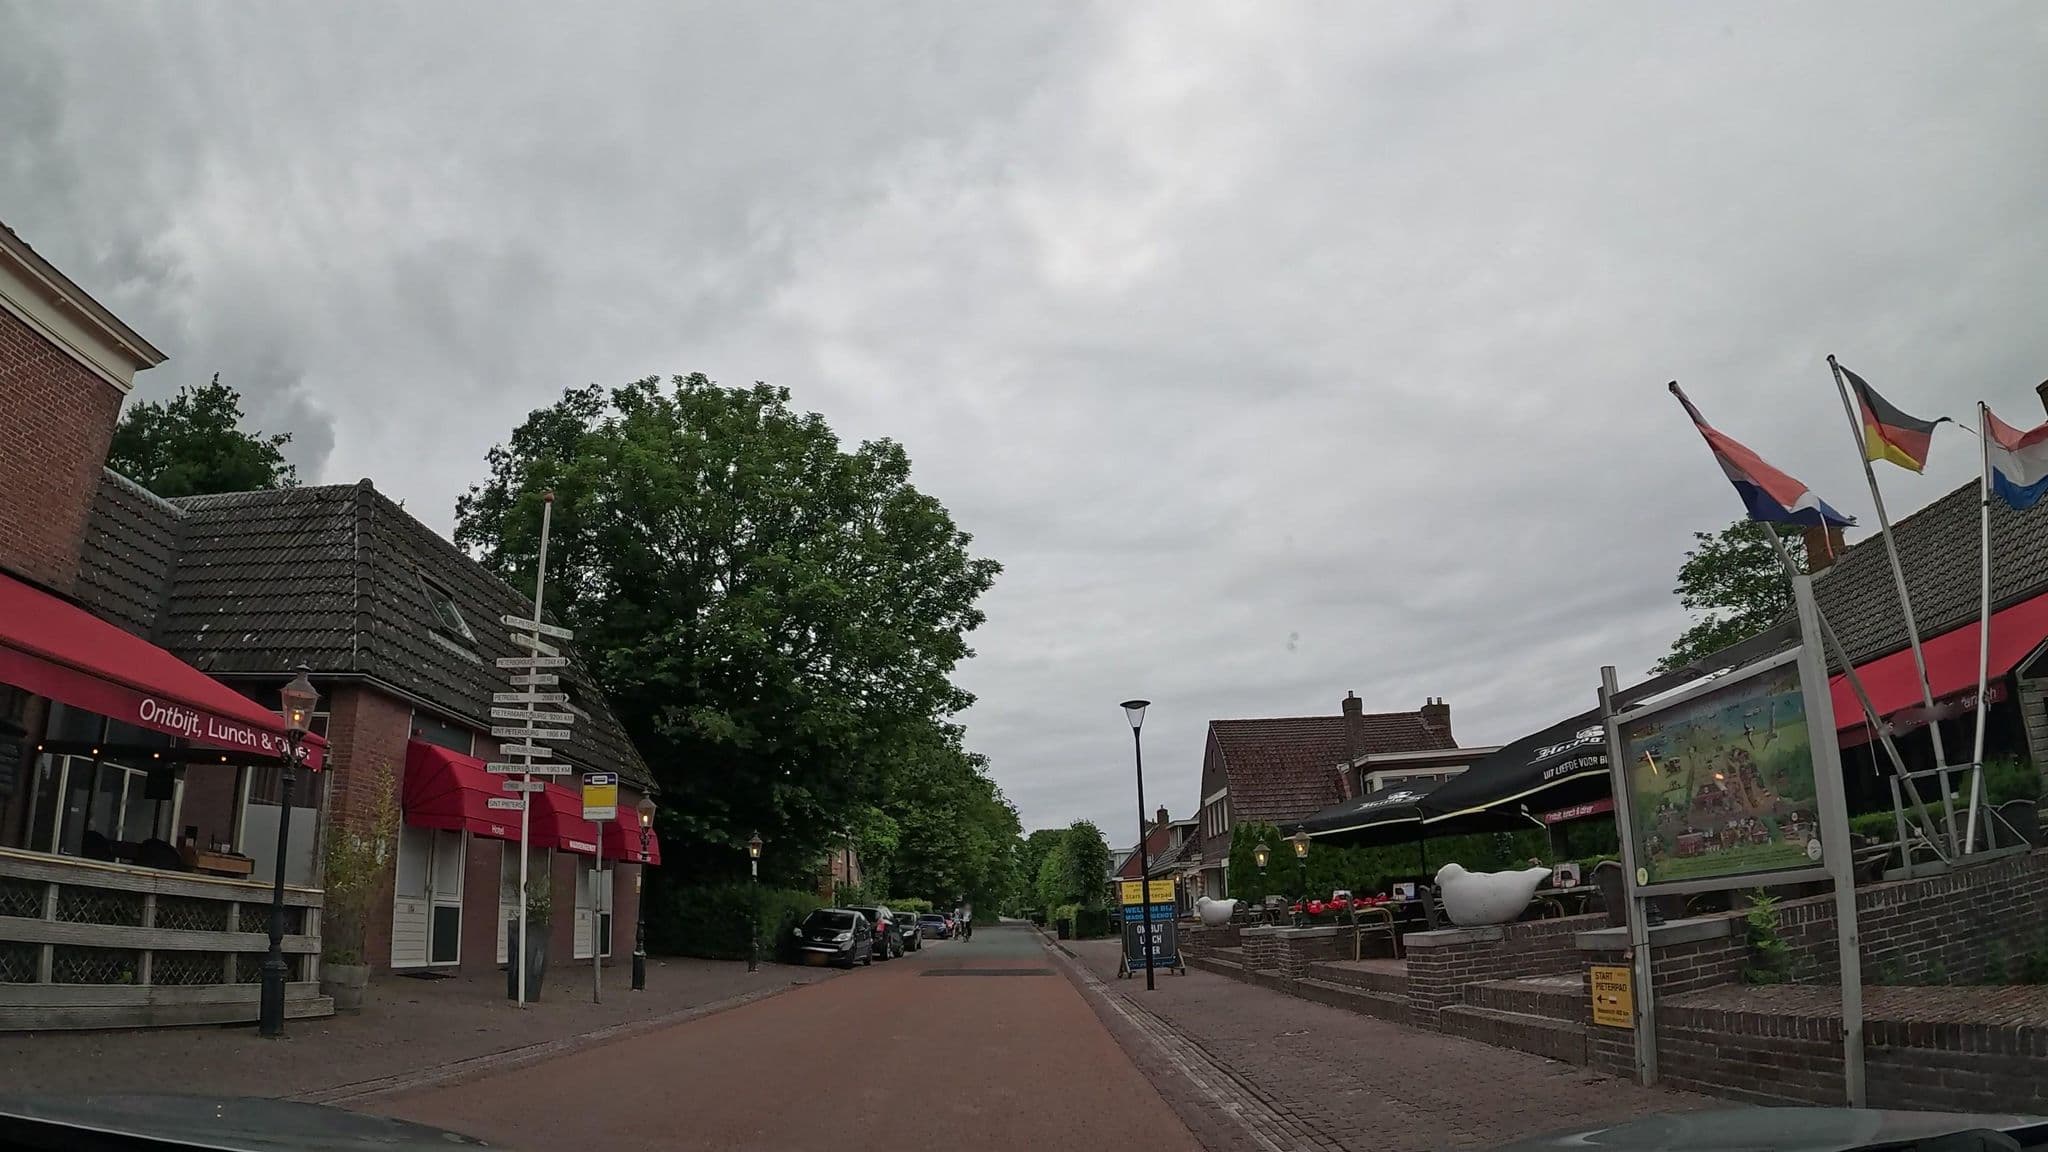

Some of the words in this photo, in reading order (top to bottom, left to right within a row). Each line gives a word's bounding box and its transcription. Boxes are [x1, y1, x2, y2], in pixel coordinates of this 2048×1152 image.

[139, 698, 203, 738] Ontbijt,
[208, 717, 257, 747] Lunch
[261, 733, 273, 750] &
[1543, 768, 1554, 780] UIT
[1555, 758, 1578, 775] LIEFDE
[1578, 756, 1598, 768] VOOR
[1595, 971, 1613, 980] START
[1596, 982, 1628, 992] PIETERPAD
